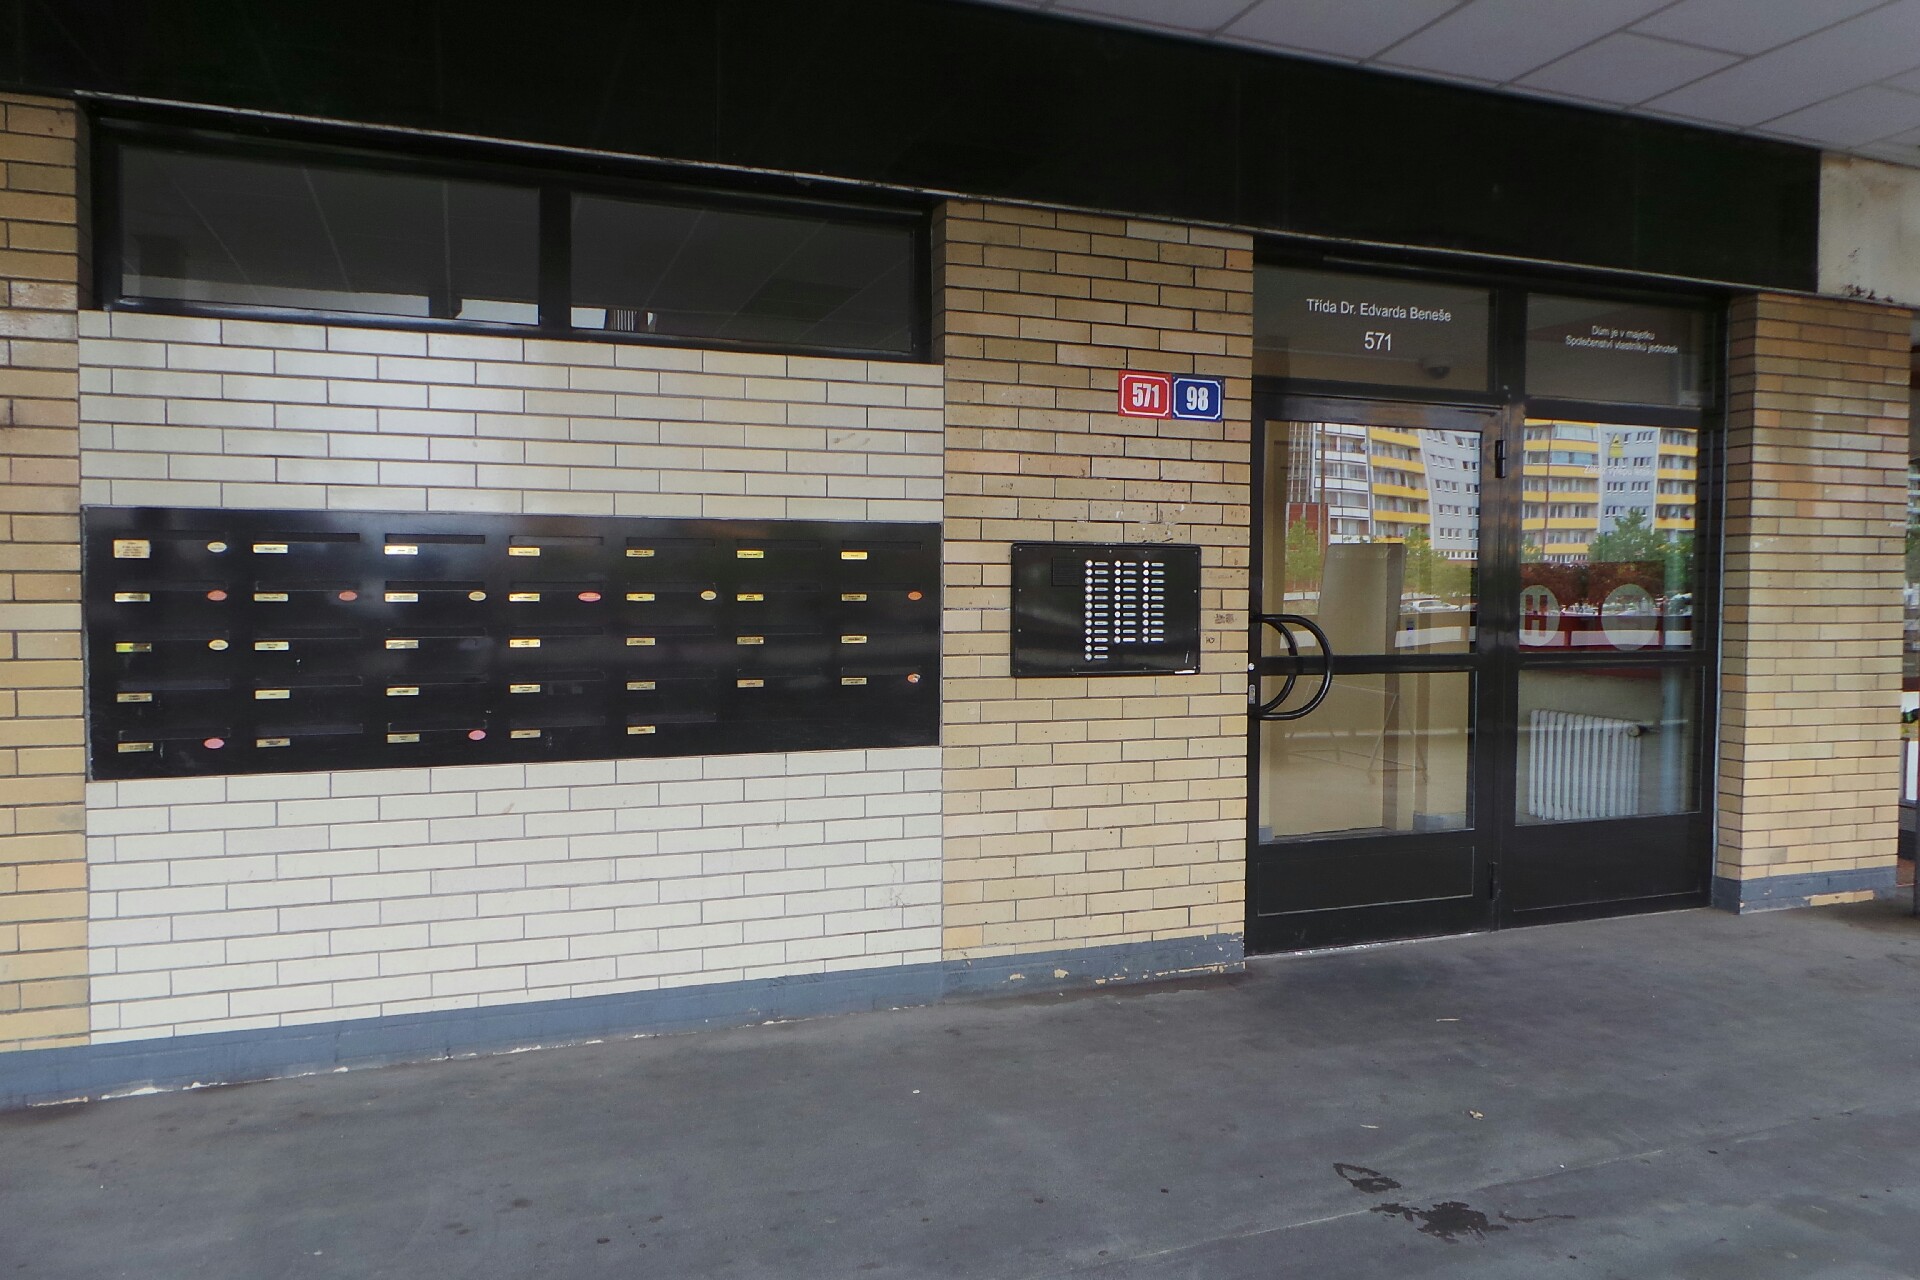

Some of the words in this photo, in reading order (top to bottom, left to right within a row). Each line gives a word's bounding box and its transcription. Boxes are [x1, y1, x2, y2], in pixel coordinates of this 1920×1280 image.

[1306, 298, 1337, 313] Třída
[1340, 300, 1357, 315] Dr.
[1360, 302, 1406, 318] Edvarda
[1410, 305, 1452, 322] Beneše
[1364, 331, 1392, 351] 571
[1132, 382, 1160, 409] 571
[1186, 386, 1209, 411] 98
